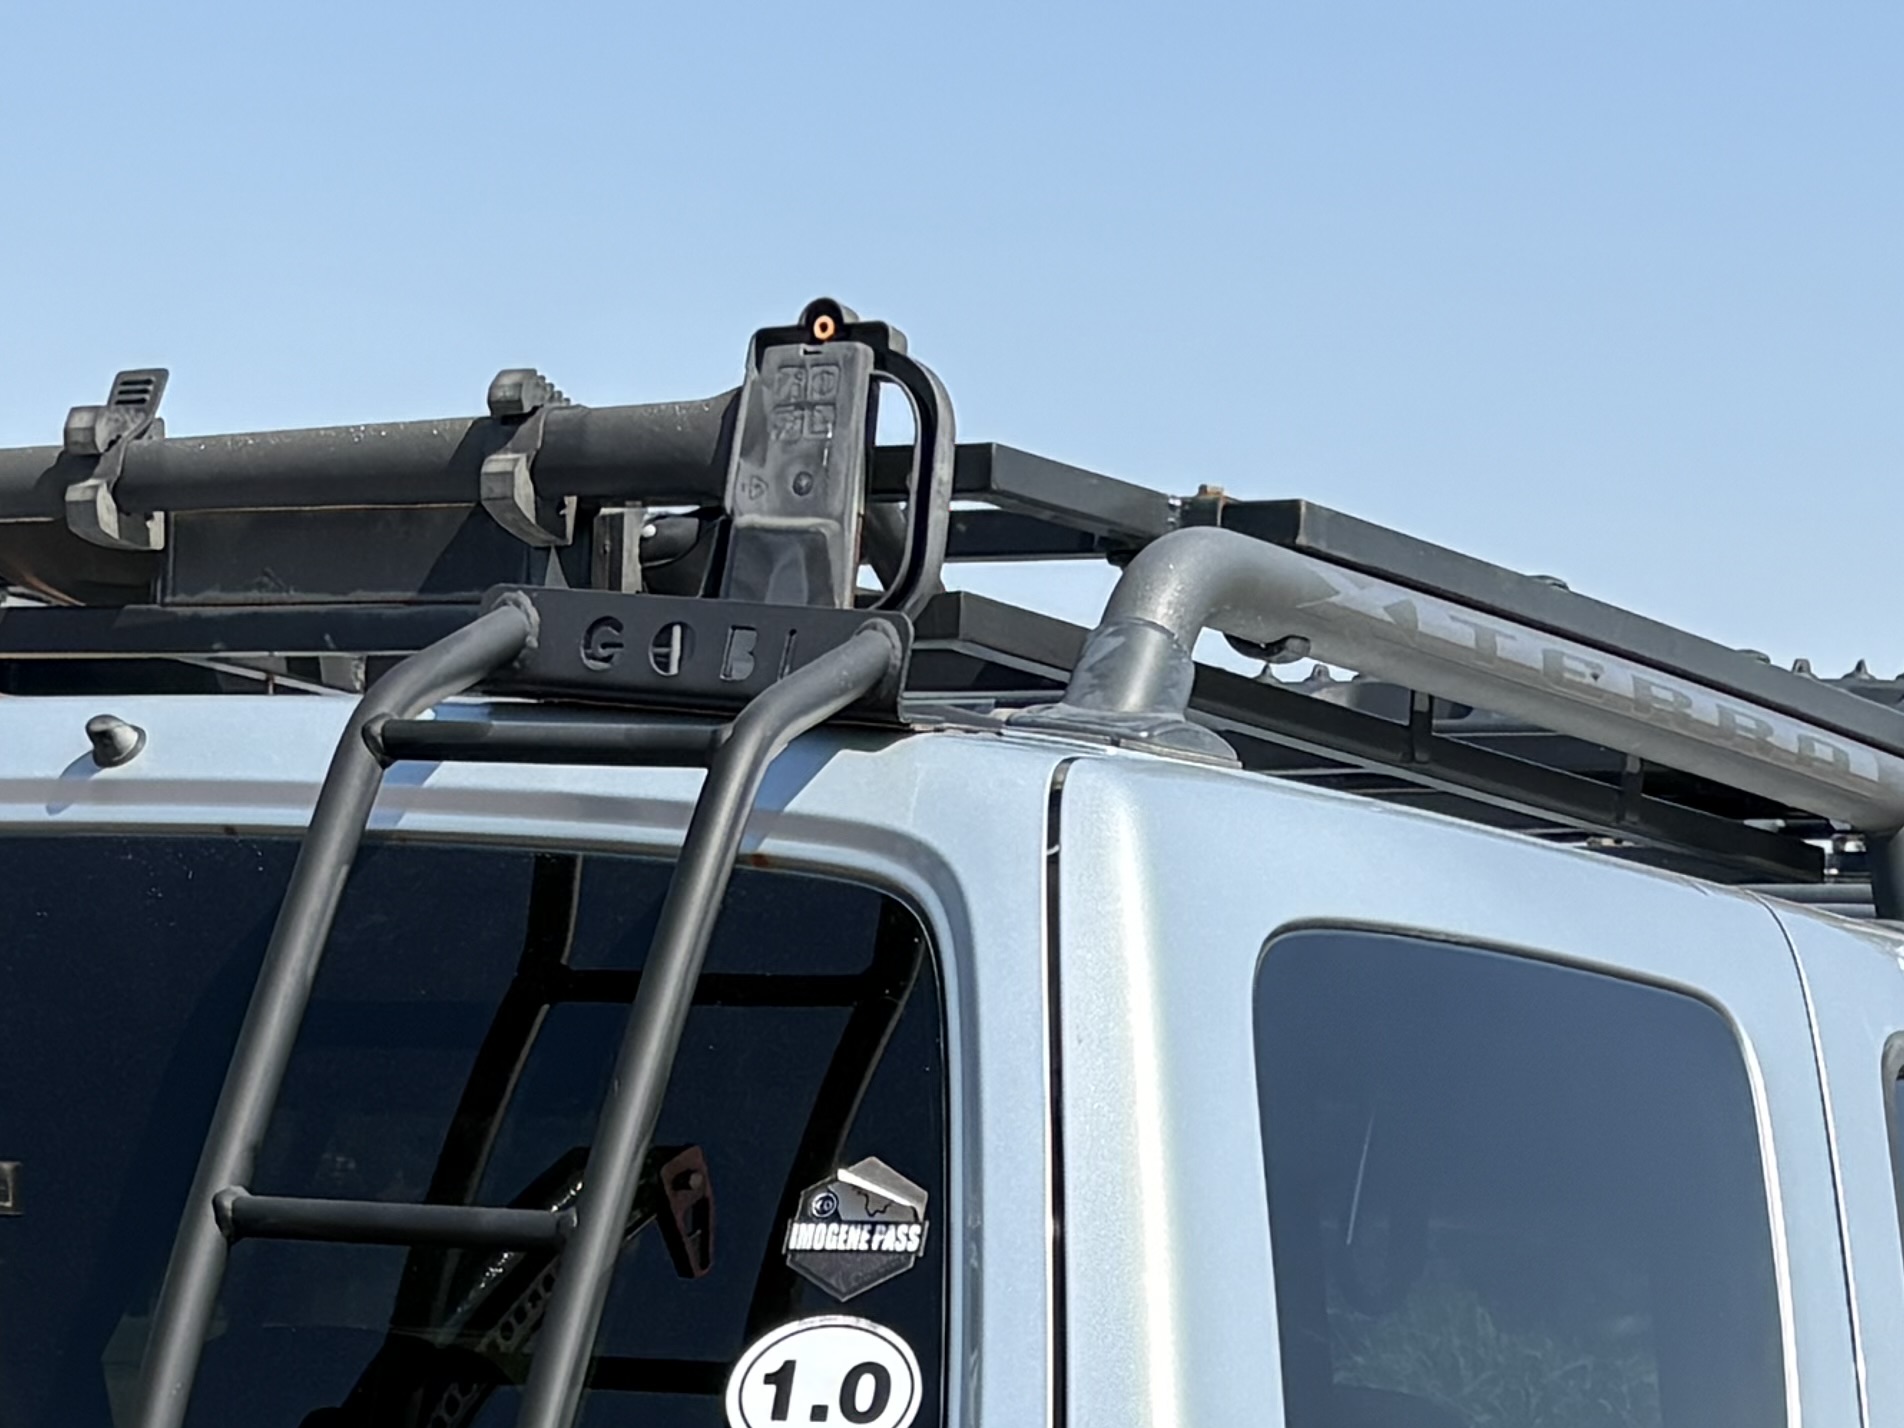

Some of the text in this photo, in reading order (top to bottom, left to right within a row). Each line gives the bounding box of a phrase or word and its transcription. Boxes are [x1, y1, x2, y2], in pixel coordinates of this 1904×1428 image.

[788, 1222, 922, 1252] IMOGENE PASS
[763, 1359, 892, 1425] 1.0
